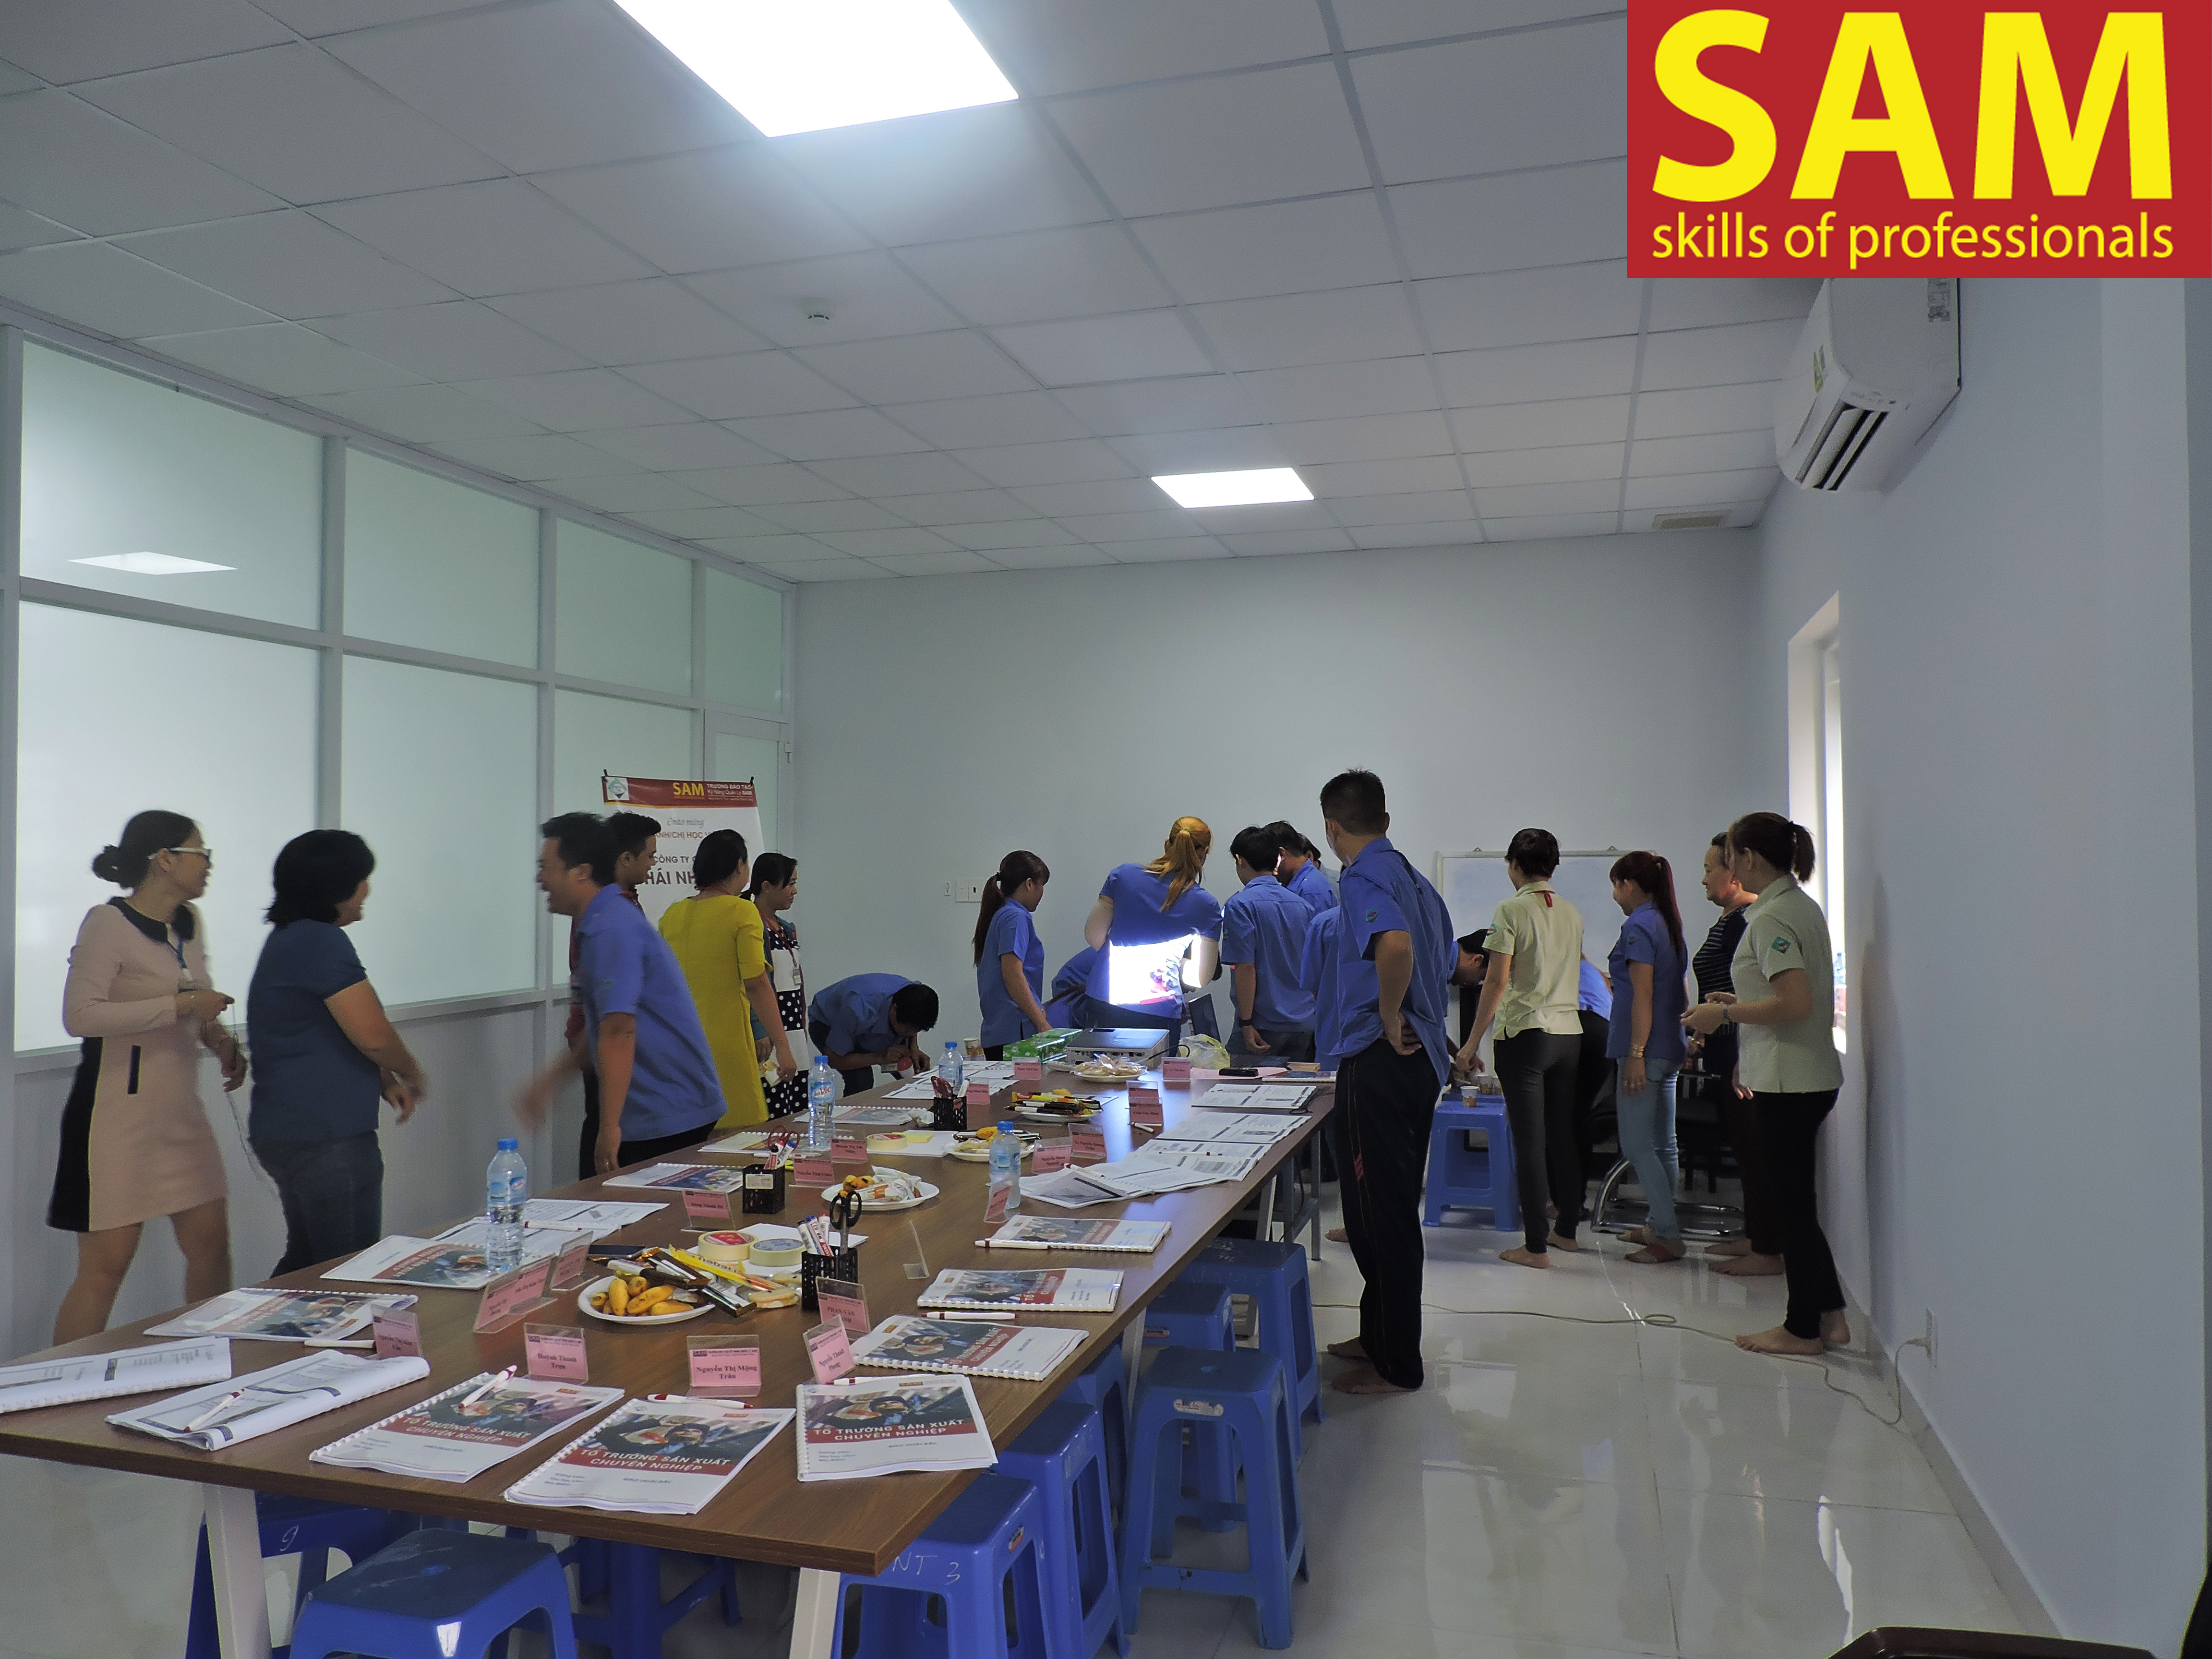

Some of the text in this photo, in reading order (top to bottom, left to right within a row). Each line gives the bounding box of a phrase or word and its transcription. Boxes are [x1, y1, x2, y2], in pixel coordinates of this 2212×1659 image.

[673, 782, 705, 795] SAM
[646, 867, 671, 885] HÁI
[835, 1428, 946, 1440] CHUYÊN NGHIỆP
[837, 1426, 892, 1434] TRƯỞNG
[897, 1422, 925, 1431] SẢN
[929, 1419, 964, 1428] XUẤT
[590, 1457, 703, 1472] CHUYÊN NGHIỆP
[945, 1562, 961, 1585] 3
